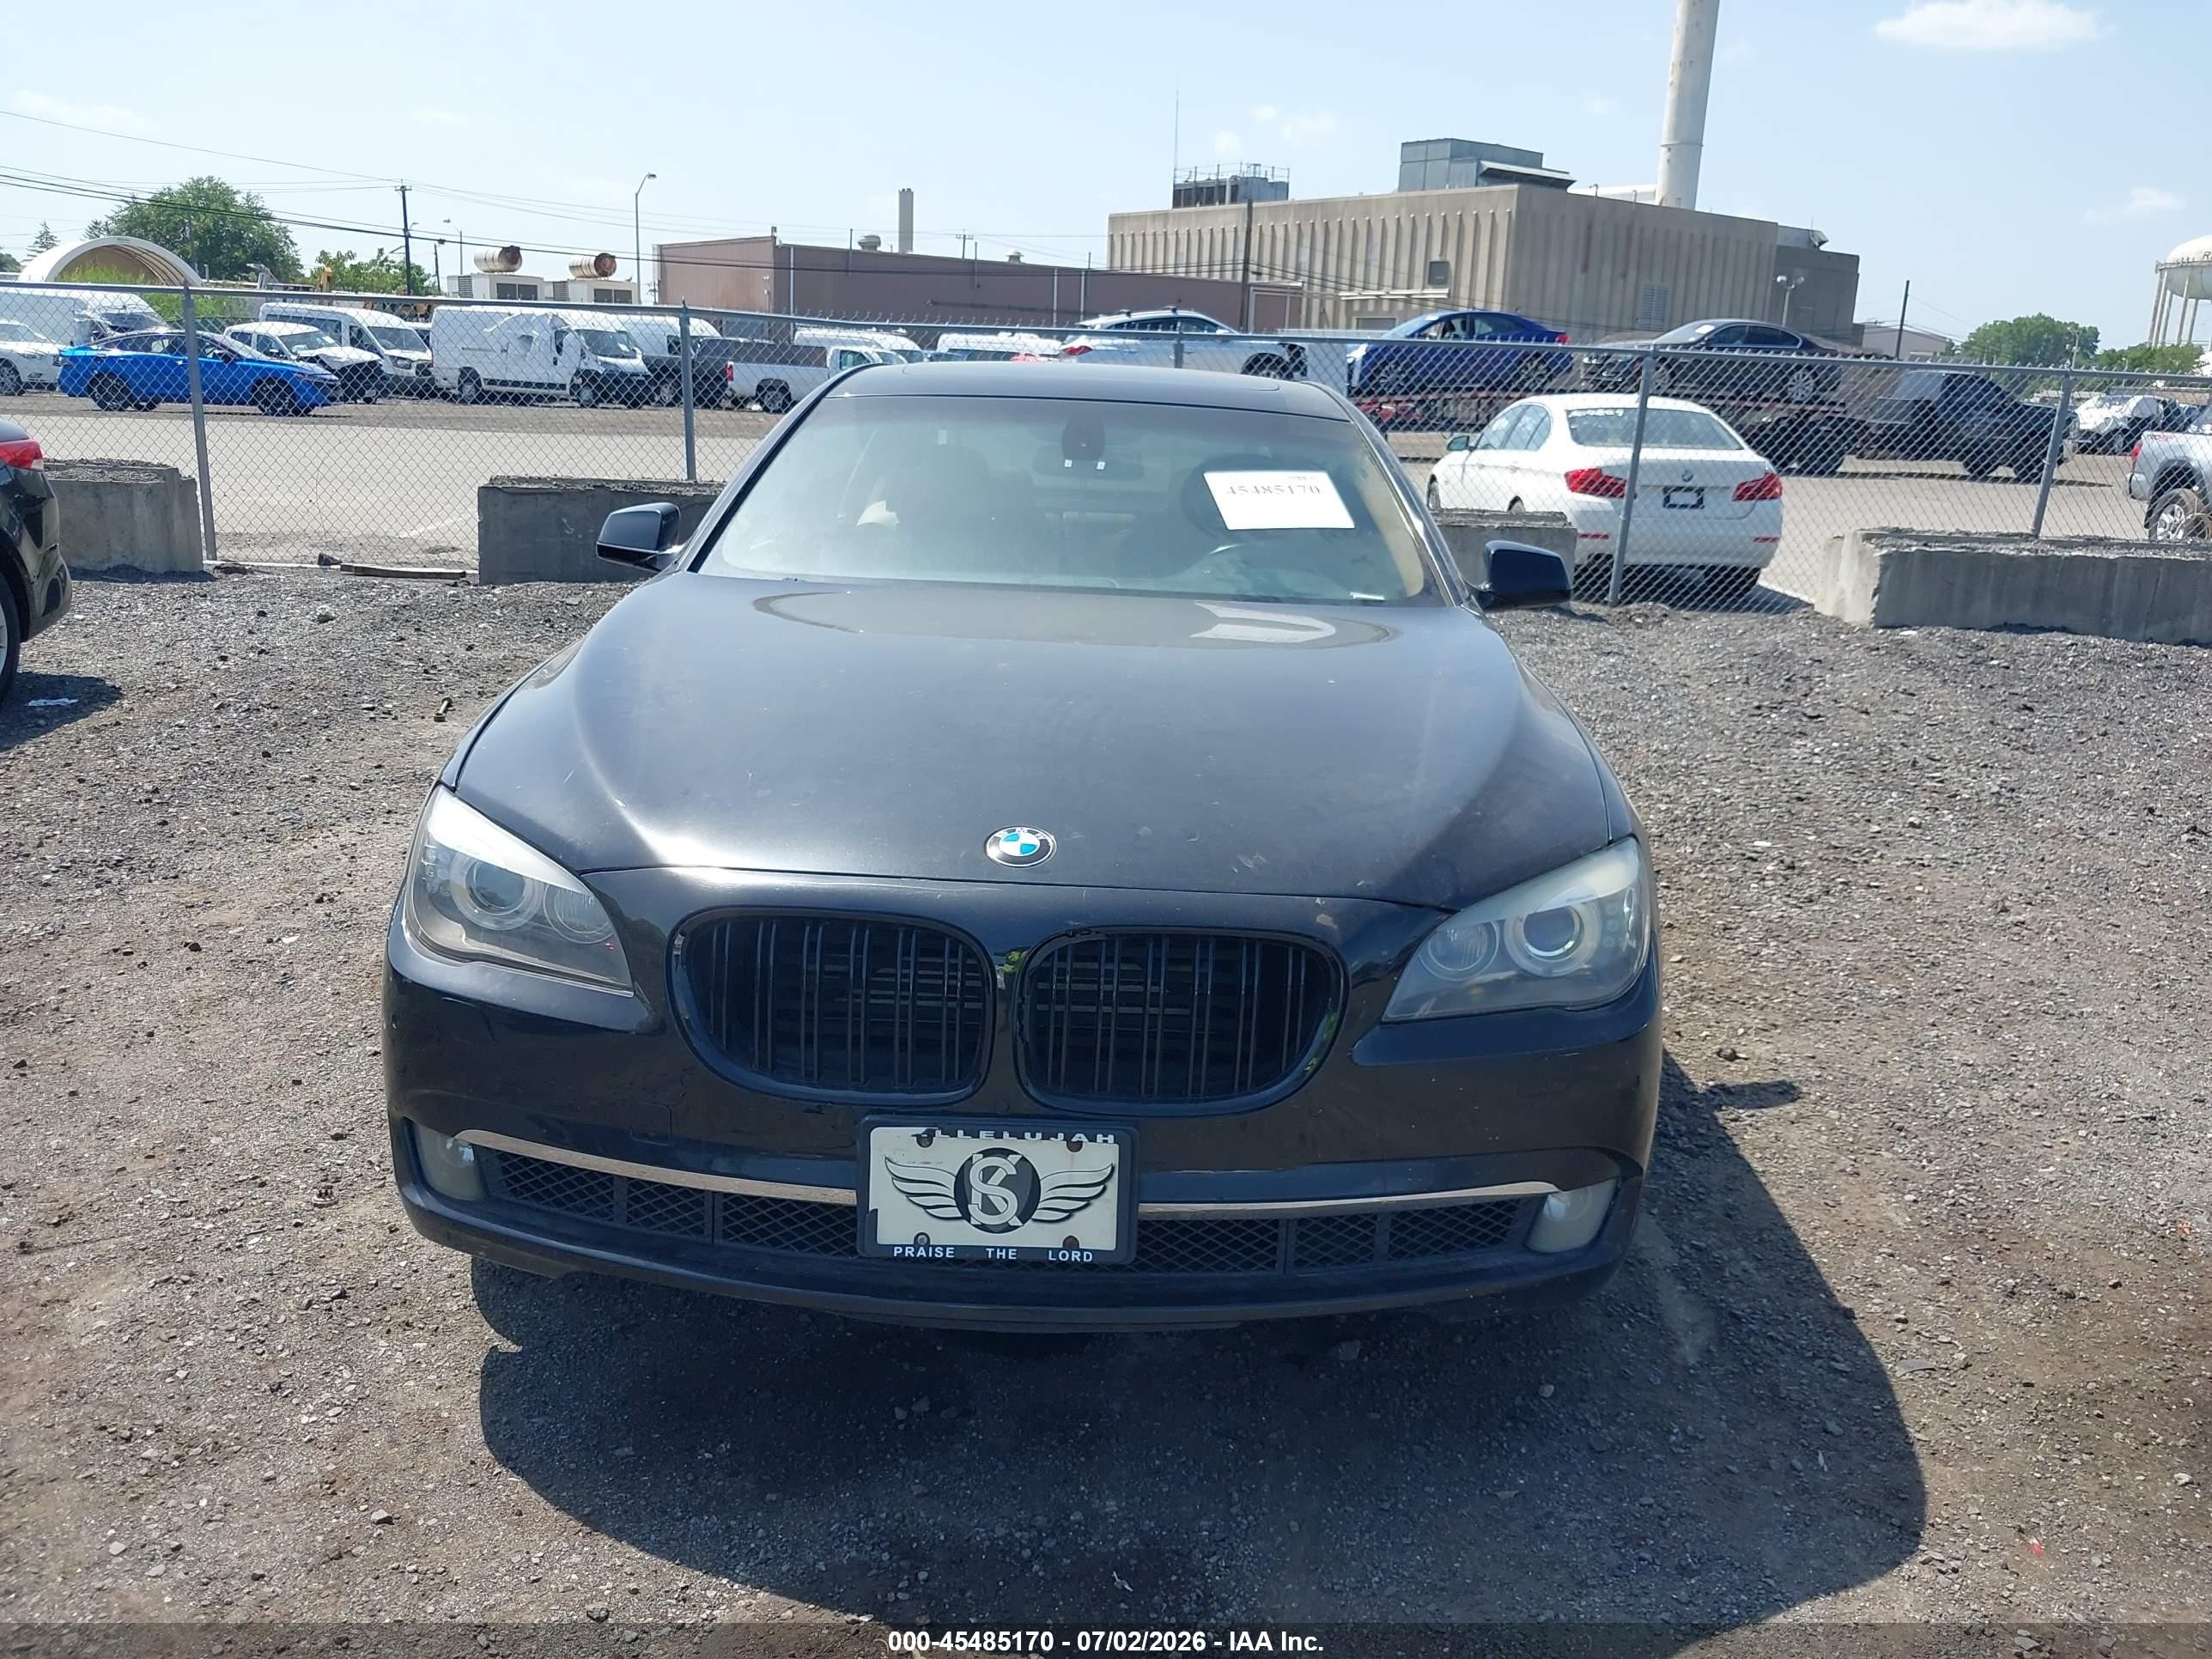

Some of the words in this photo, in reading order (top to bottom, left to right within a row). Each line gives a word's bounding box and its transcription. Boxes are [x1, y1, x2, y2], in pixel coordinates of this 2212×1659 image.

[2203, 251, 2212, 259] R
[922, 1129, 1115, 1144] LLELUJAH
[893, 1246, 955, 1258] PRAISE
[985, 1248, 1018, 1260] THE
[1048, 1249, 1093, 1262] LORD
